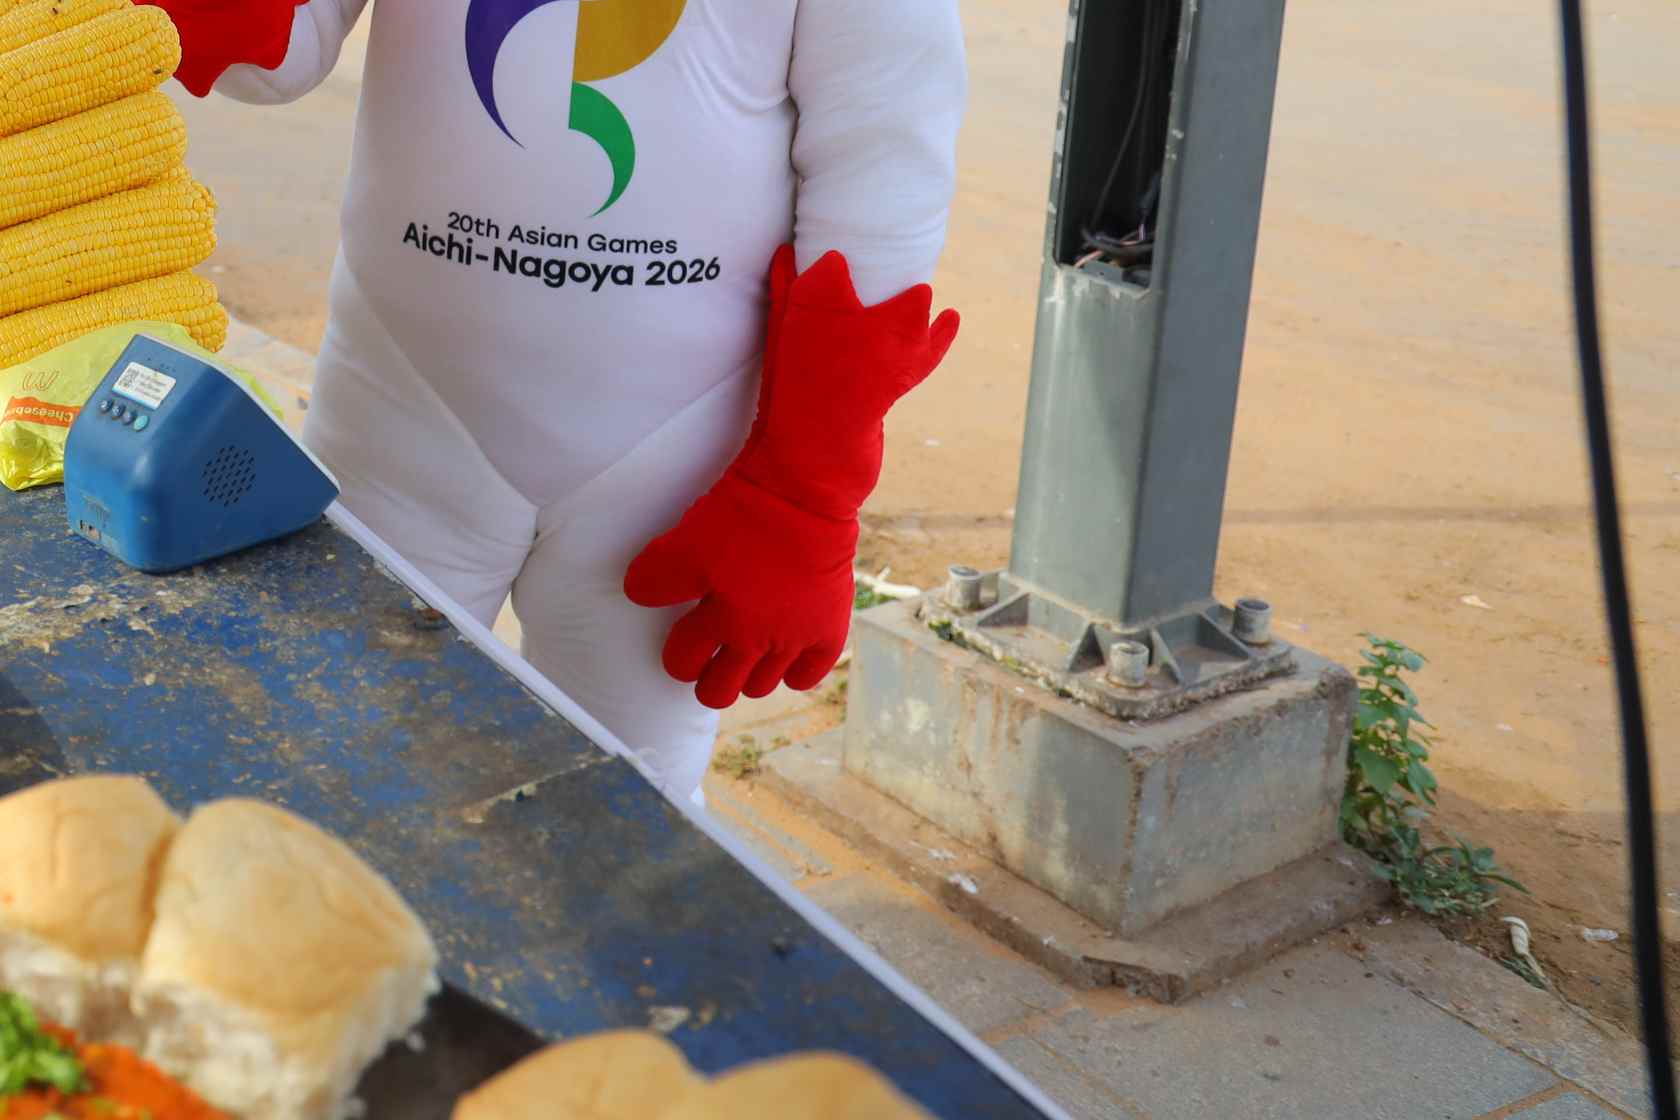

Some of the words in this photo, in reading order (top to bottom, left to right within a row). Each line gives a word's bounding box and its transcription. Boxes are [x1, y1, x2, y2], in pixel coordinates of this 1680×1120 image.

[402, 221, 635, 292] Aichi-Nagoya
[644, 256, 722, 287] 2026
[447, 211, 500, 240] 20th
[507, 224, 580, 251] Asian
[586, 233, 679, 255] Games
